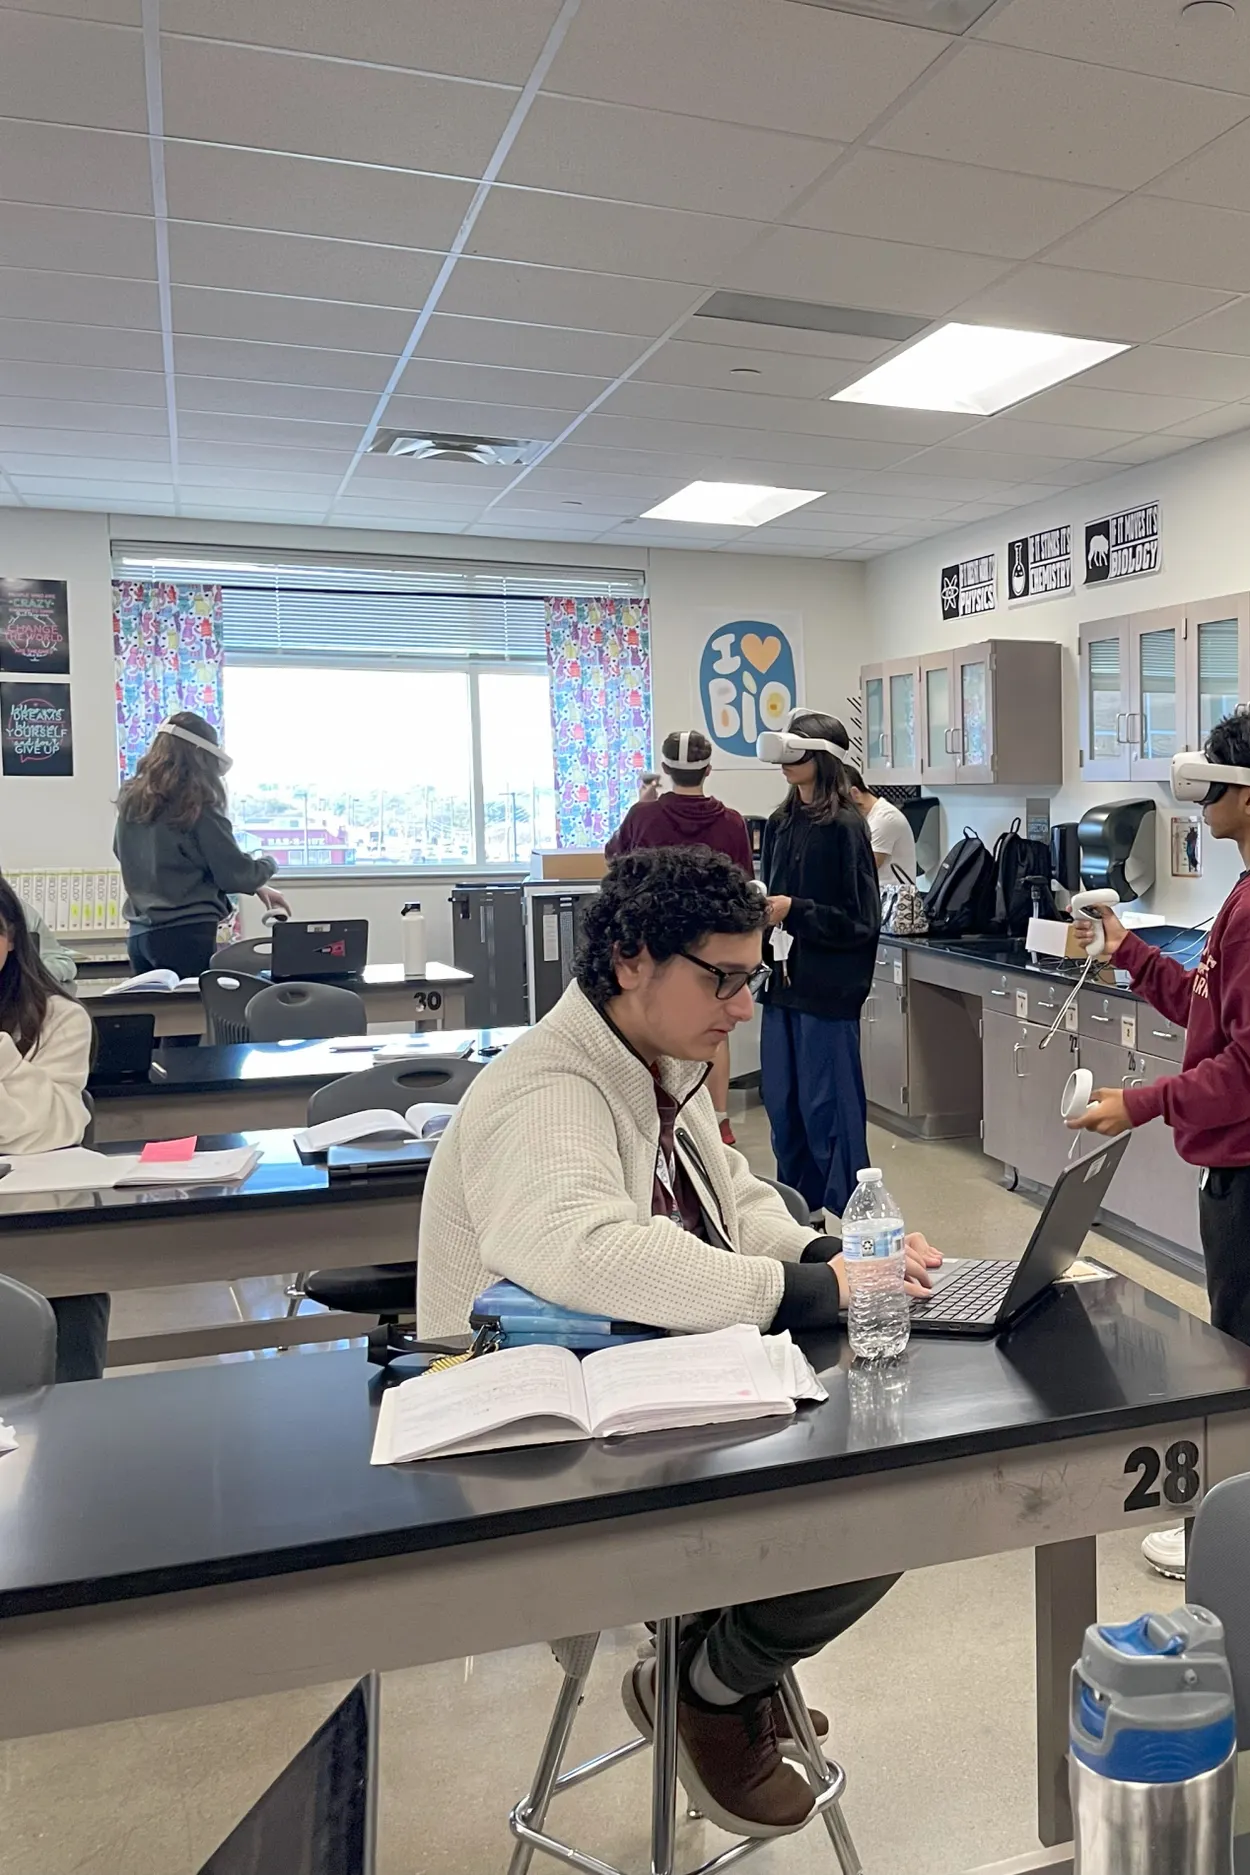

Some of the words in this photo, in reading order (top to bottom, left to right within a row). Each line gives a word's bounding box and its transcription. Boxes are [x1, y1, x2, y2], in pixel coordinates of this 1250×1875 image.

[1110, 541, 1158, 578] BIOLOGY
[1030, 560, 1071, 595] CHEMISTRY
[13, 598, 52, 609] CRAZY
[960, 585, 995, 616] PHYSICS
[5, 631, 25, 641] THE
[26, 632, 63, 642] WORLD
[8, 624, 58, 635] CHANGE
[711, 633, 741, 675] I
[13, 711, 62, 721] DREAMS
[5, 728, 68, 738] YOURSELF
[14, 745, 41, 755] GIVE
[43, 745, 60, 755] UP
[414, 991, 442, 1011] 30
[1123, 1440, 1200, 1512] 28
